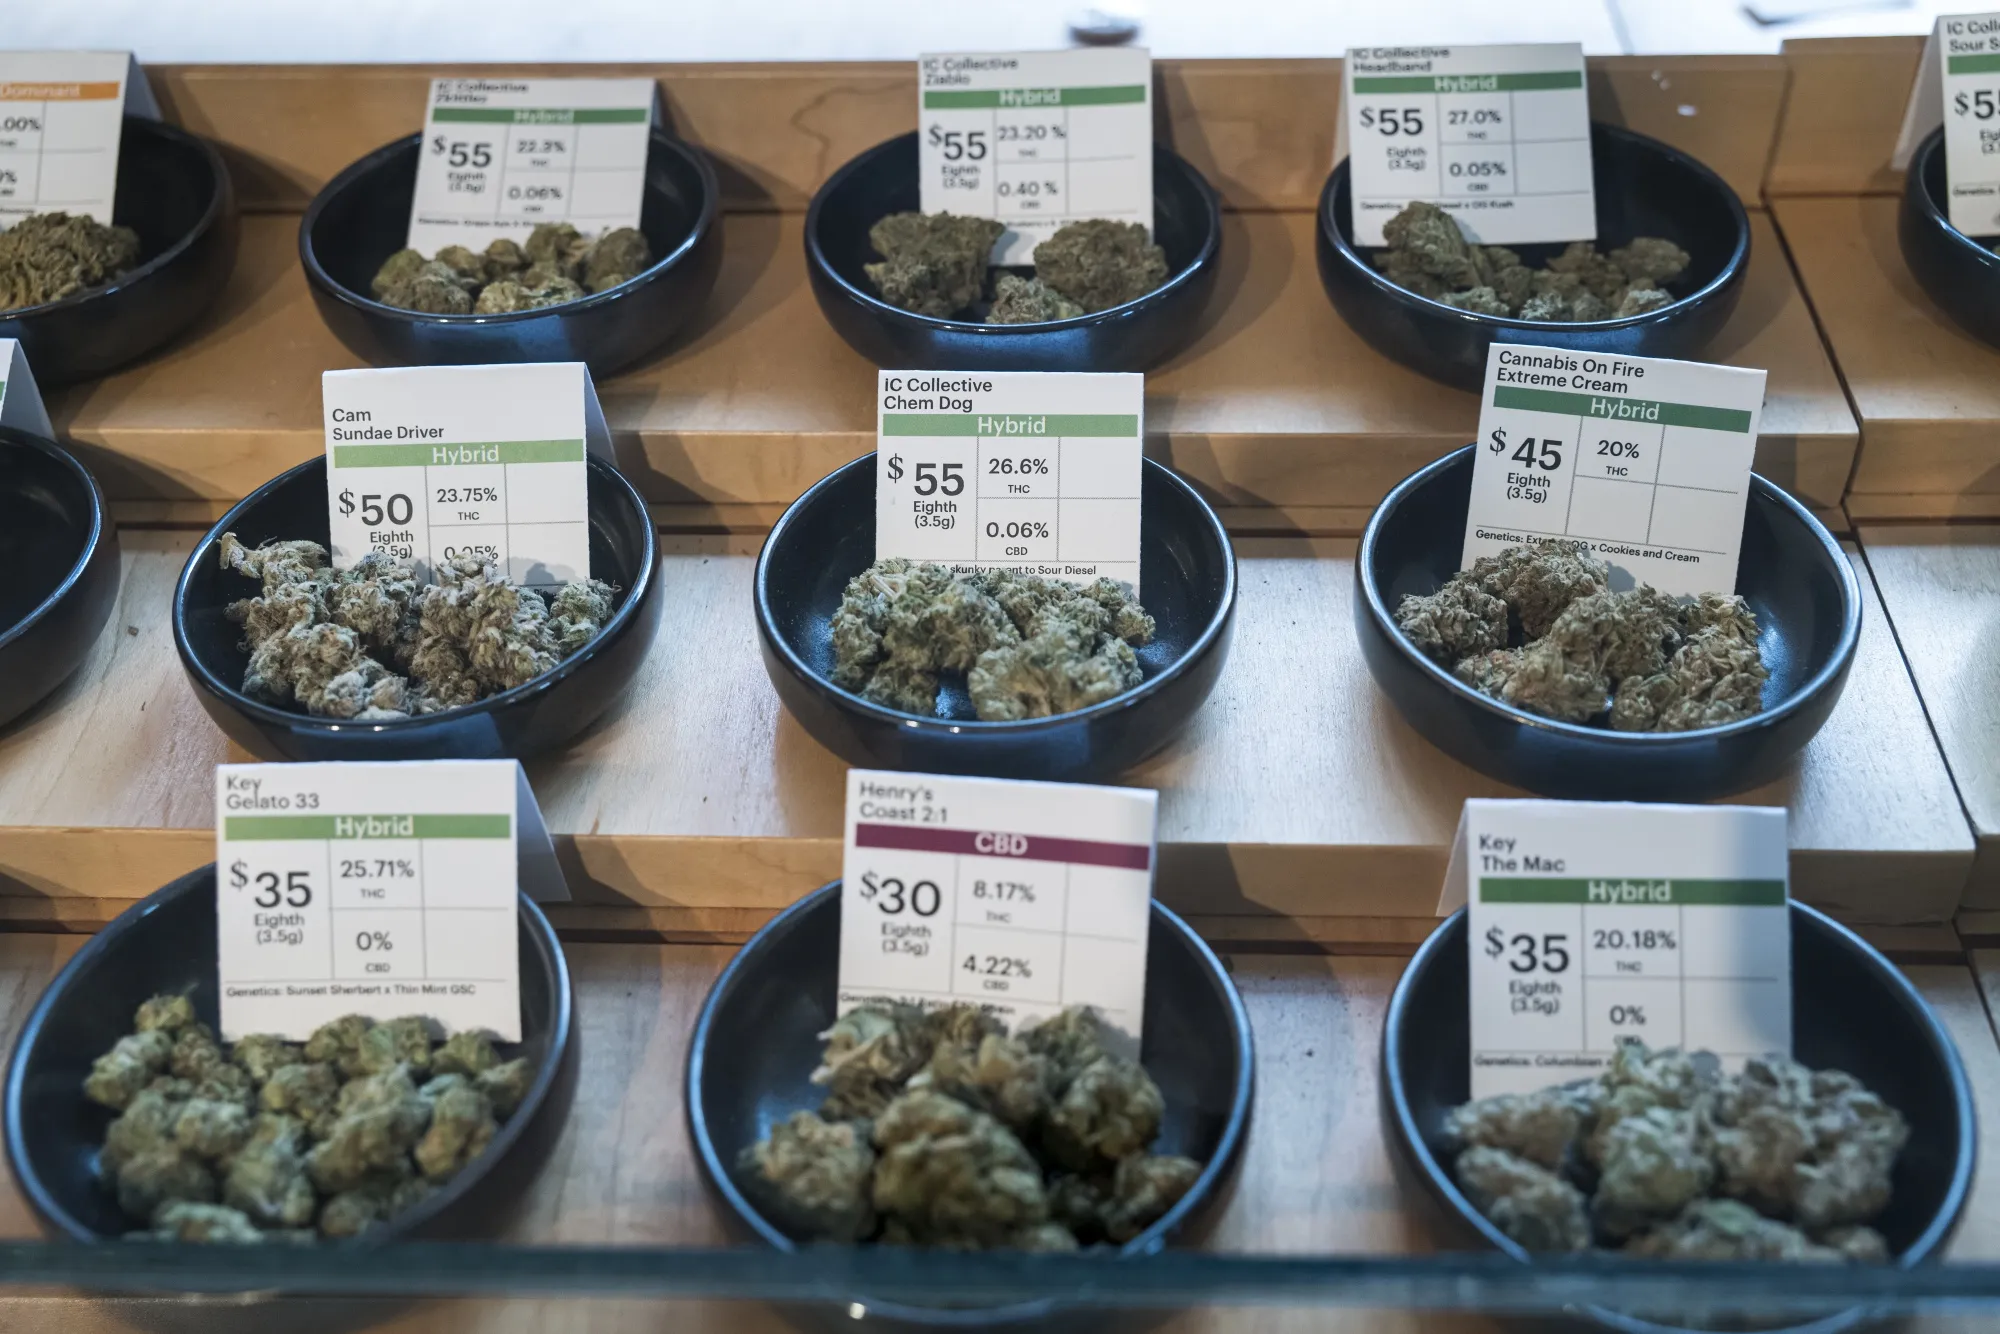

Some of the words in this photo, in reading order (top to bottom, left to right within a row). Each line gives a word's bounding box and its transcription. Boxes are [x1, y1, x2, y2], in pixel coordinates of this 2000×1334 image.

[1947, 22, 1963, 35] IC
[1950, 38, 1984, 52] Sour
[1373, 48, 1450, 59] Collective
[943, 59, 1019, 71] Collective
[1353, 61, 1432, 73] Headband
[1435, 76, 1497, 92] Hybrid
[999, 89, 1061, 106] Hybrid
[1955, 91, 2000, 119] $5
[513, 110, 574, 124] Hybrid
[1448, 110, 1502, 125] 27.0%
[1387, 148, 1427, 160] Eighth
[942, 165, 980, 178] Eighth
[1449, 163, 1506, 176] 0.05%
[1499, 351, 1578, 371] Cannabis
[1582, 359, 1608, 374] On
[1612, 362, 1645, 378] Fire
[907, 378, 992, 392] Collective
[1497, 368, 1567, 388] Extreme
[1572, 375, 1627, 394] Cream
[884, 396, 934, 410] Chem
[939, 396, 973, 412] Dog
[1590, 398, 1660, 421] Hybrid
[332, 408, 371, 422] Cam
[333, 427, 392, 440] Sundae
[397, 427, 444, 439] Driver
[978, 416, 1046, 436] Hybrid
[432, 445, 499, 465] Hybrid
[1597, 440, 1639, 459] 20%
[988, 459, 1049, 474] 26.6%
[1606, 466, 1627, 477] THC
[1507, 473, 1550, 488] Eighth
[437, 488, 498, 502] 23.75%
[1008, 485, 1030, 493] THC
[1507, 487, 1547, 503] (3.5g)
[458, 511, 480, 520] THC
[913, 501, 957, 515] Eighth
[914, 515, 955, 529] (3.5g)
[986, 522, 1049, 538] 0.06%
[370, 531, 414, 544] Eighth
[1005, 547, 1028, 556] CBD
[1475, 530, 1524, 544] Genetics:
[1599, 543, 1640, 556] Cookies
[1643, 547, 1662, 558] and
[1665, 550, 1700, 564] Cream
[989, 566, 1022, 575] paent
[1025, 565, 1035, 574] to
[1038, 565, 1062, 574] Sour
[1065, 565, 1096, 575] Diesel
[226, 776, 262, 796] Key
[860, 782, 933, 802] Henry's
[227, 794, 290, 809] Gelato
[296, 794, 320, 808] 33
[860, 803, 916, 821] Coast
[922, 806, 948, 822] 2:1
[335, 817, 413, 840] Hybrid
[975, 833, 1028, 855] CBD
[1479, 835, 1516, 854] Key
[340, 860, 414, 878] 25.71%
[1482, 856, 1517, 872] The
[1523, 857, 1565, 873] Mac
[361, 888, 385, 898] THC
[974, 881, 1035, 902] 8.17%
[1588, 881, 1672, 904] Hybrid
[254, 913, 305, 929] Eighth
[256, 929, 303, 946] (3.5g)
[881, 923, 932, 938] Eighth
[356, 932, 393, 951] 0%
[882, 939, 929, 955] (3.5g)
[1594, 931, 1676, 949] 20.18%
[365, 963, 390, 973] CBD
[963, 956, 1031, 978] 4.22%
[1615, 961, 1642, 972] THC
[1509, 981, 1562, 996] Eighth
[1511, 997, 1560, 1015] (3.5g)
[1610, 1006, 1645, 1025] 0%
